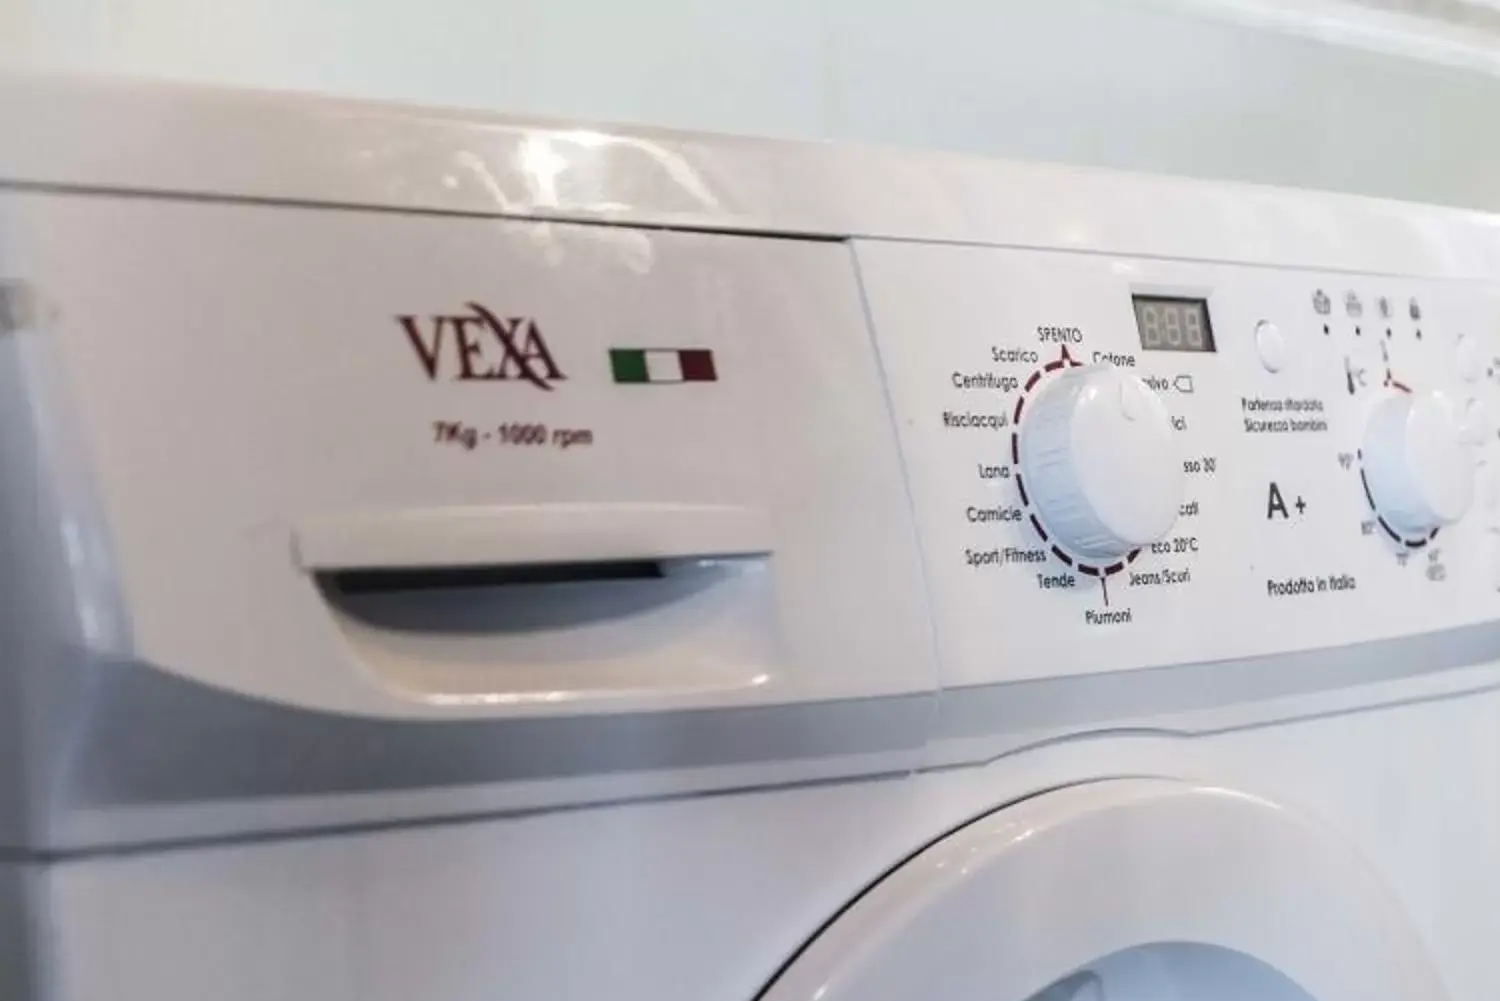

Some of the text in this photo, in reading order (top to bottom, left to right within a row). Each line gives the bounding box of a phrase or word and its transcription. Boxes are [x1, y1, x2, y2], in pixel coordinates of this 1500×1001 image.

[1037, 326, 1083, 342] SPENTO
[394, 301, 569, 391] VEXA
[991, 346, 1039, 363] Scarico
[952, 371, 1019, 392] Centrifuga
[943, 411, 1009, 431] Risciacqui
[433, 419, 478, 450] 7Kg
[499, 420, 546, 445] 1000
[552, 429, 593, 449] rpm
[979, 464, 1010, 479] Lana
[966, 504, 1023, 523] Camicie
[965, 547, 1047, 568] Sport/Fitness
[1037, 572, 1076, 590] Tende
[1128, 567, 1191, 586] Jeans/Scuri
[1267, 573, 1356, 596] Prodotto in Italia
[1085, 608, 1132, 625] Piumoni
